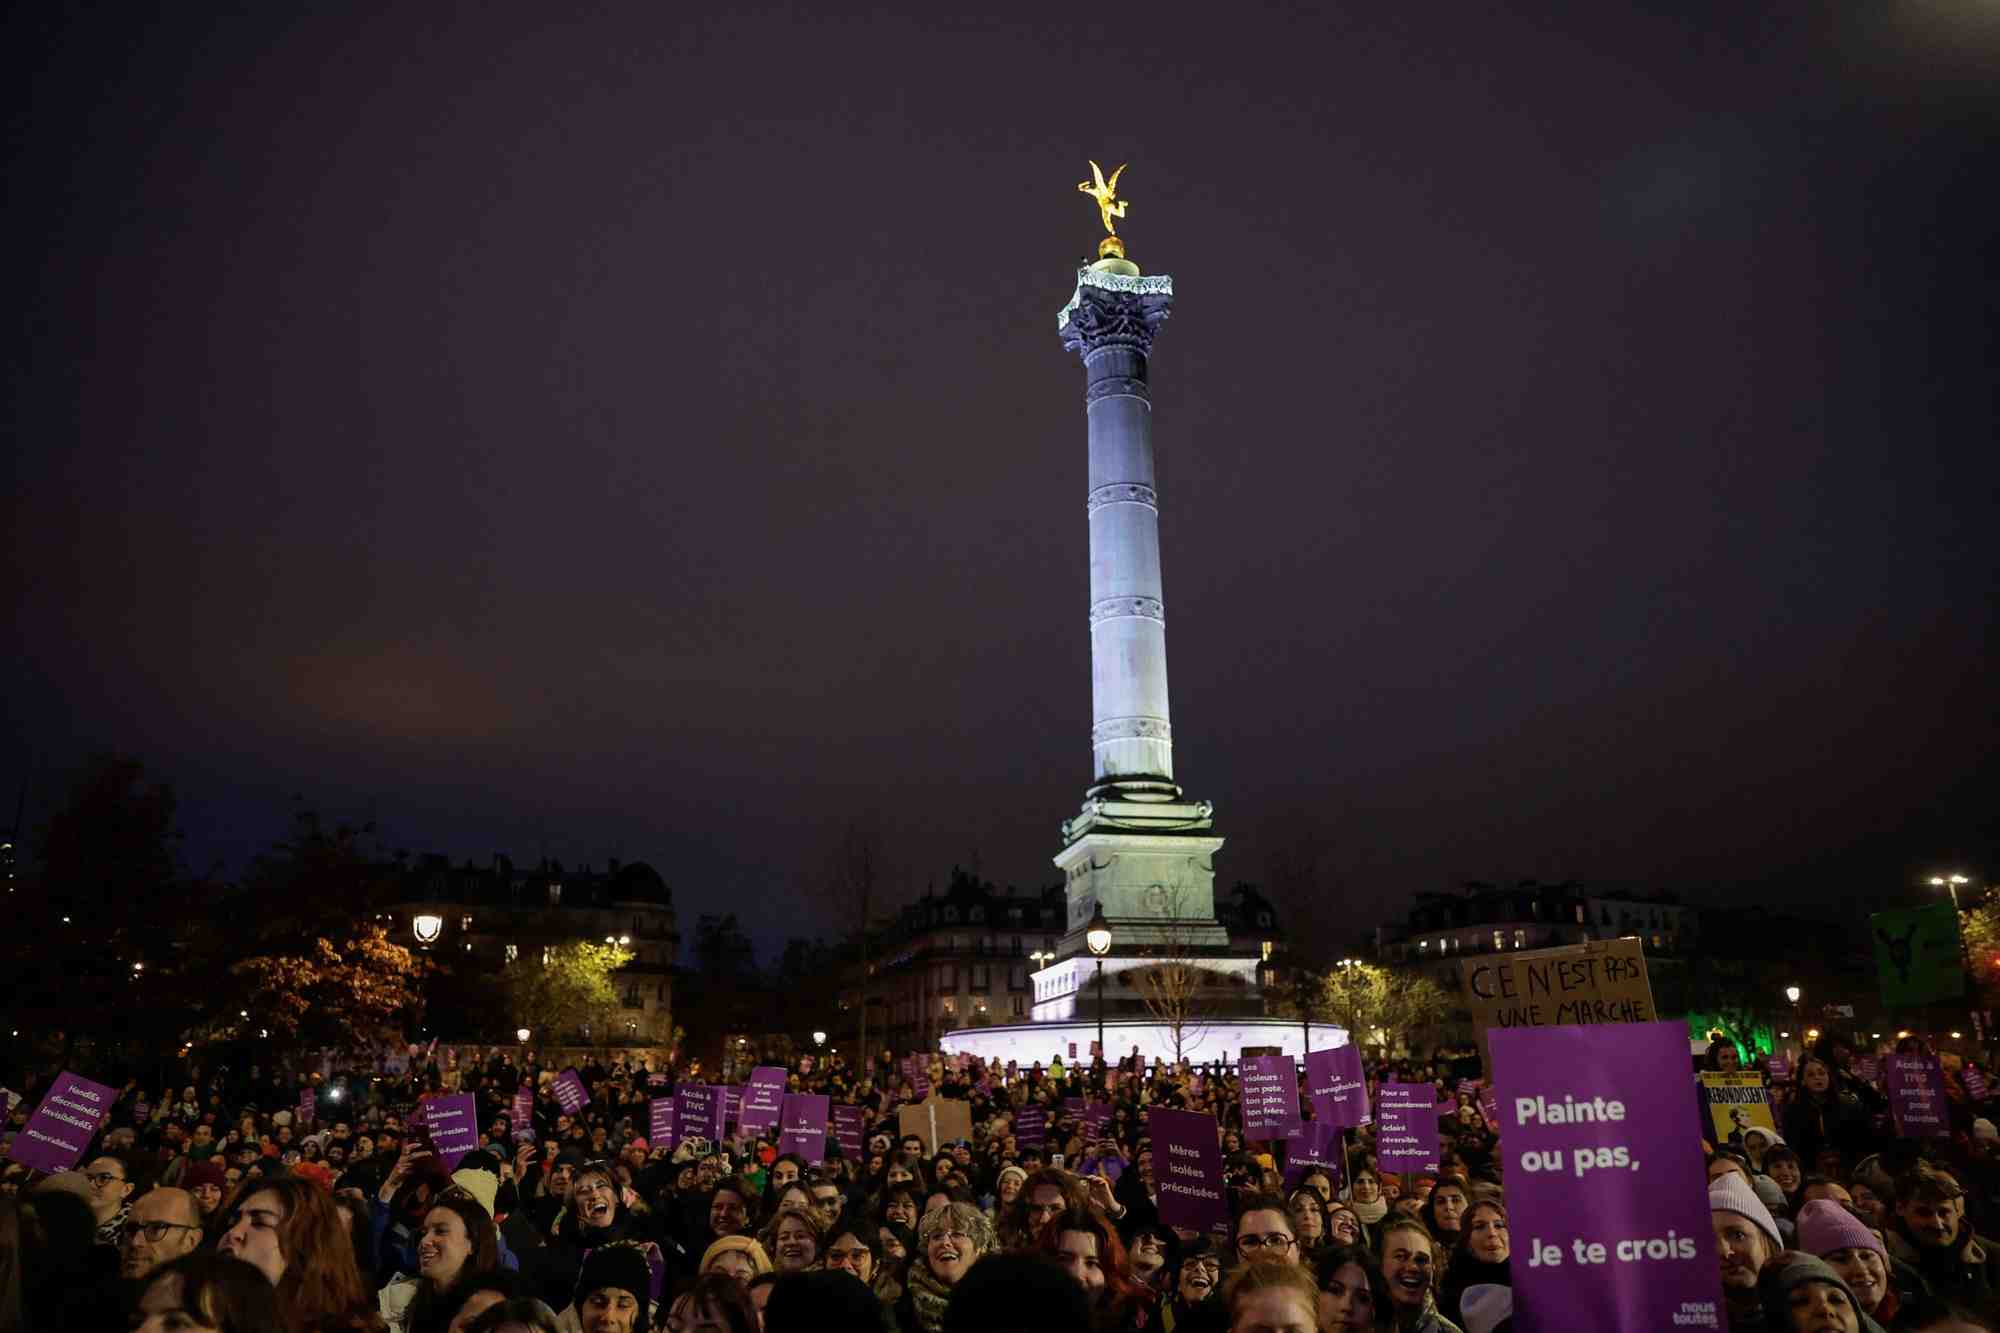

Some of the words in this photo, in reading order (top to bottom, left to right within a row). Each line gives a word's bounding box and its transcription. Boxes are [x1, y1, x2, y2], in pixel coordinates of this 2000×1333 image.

[1472, 966, 1518, 998] CE
[1527, 958, 1597, 995] N'EST
[1603, 956, 1639, 983] PAS
[1497, 1003, 1545, 1027] UNE
[1556, 1000, 1648, 1025] MARCHE
[1515, 1095, 1626, 1126] Plainte
[1169, 1144, 1200, 1158] Mères
[1520, 1150, 1563, 1172] ou
[1573, 1146, 1641, 1178] pas,
[1160, 1182, 1221, 1200] précarisées
[1528, 1238, 1562, 1268] Je
[1572, 1239, 1607, 1264] te
[1616, 1230, 1697, 1261] crois
[1673, 1312, 1718, 1326] toutes
[1681, 1302, 1716, 1314] nous
